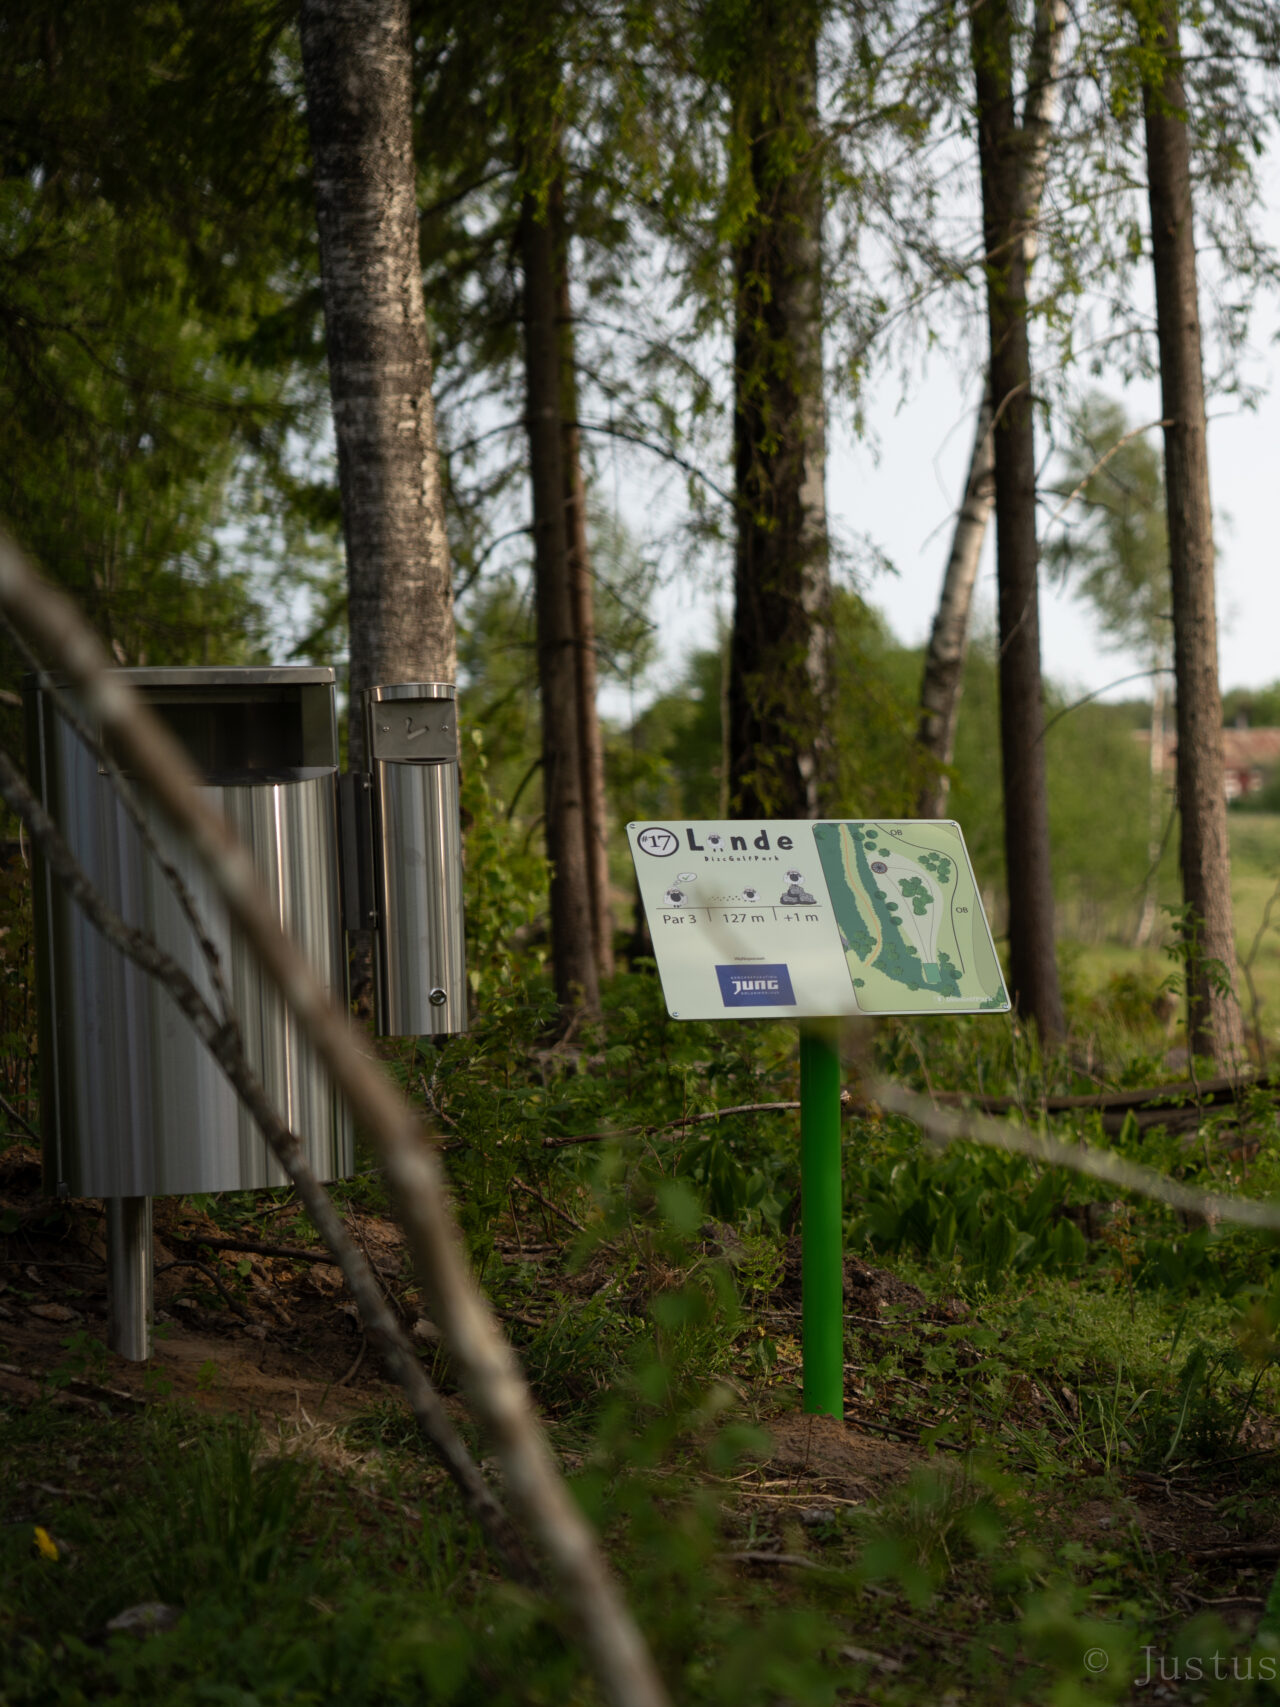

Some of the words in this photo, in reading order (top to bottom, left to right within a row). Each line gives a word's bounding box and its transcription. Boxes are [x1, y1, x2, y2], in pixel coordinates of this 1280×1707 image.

[641, 834, 671, 851] #17
[663, 914, 685, 924] Par
[689, 914, 697, 924] 3
[723, 914, 746, 923] 127
[784, 913, 800, 922] +1
